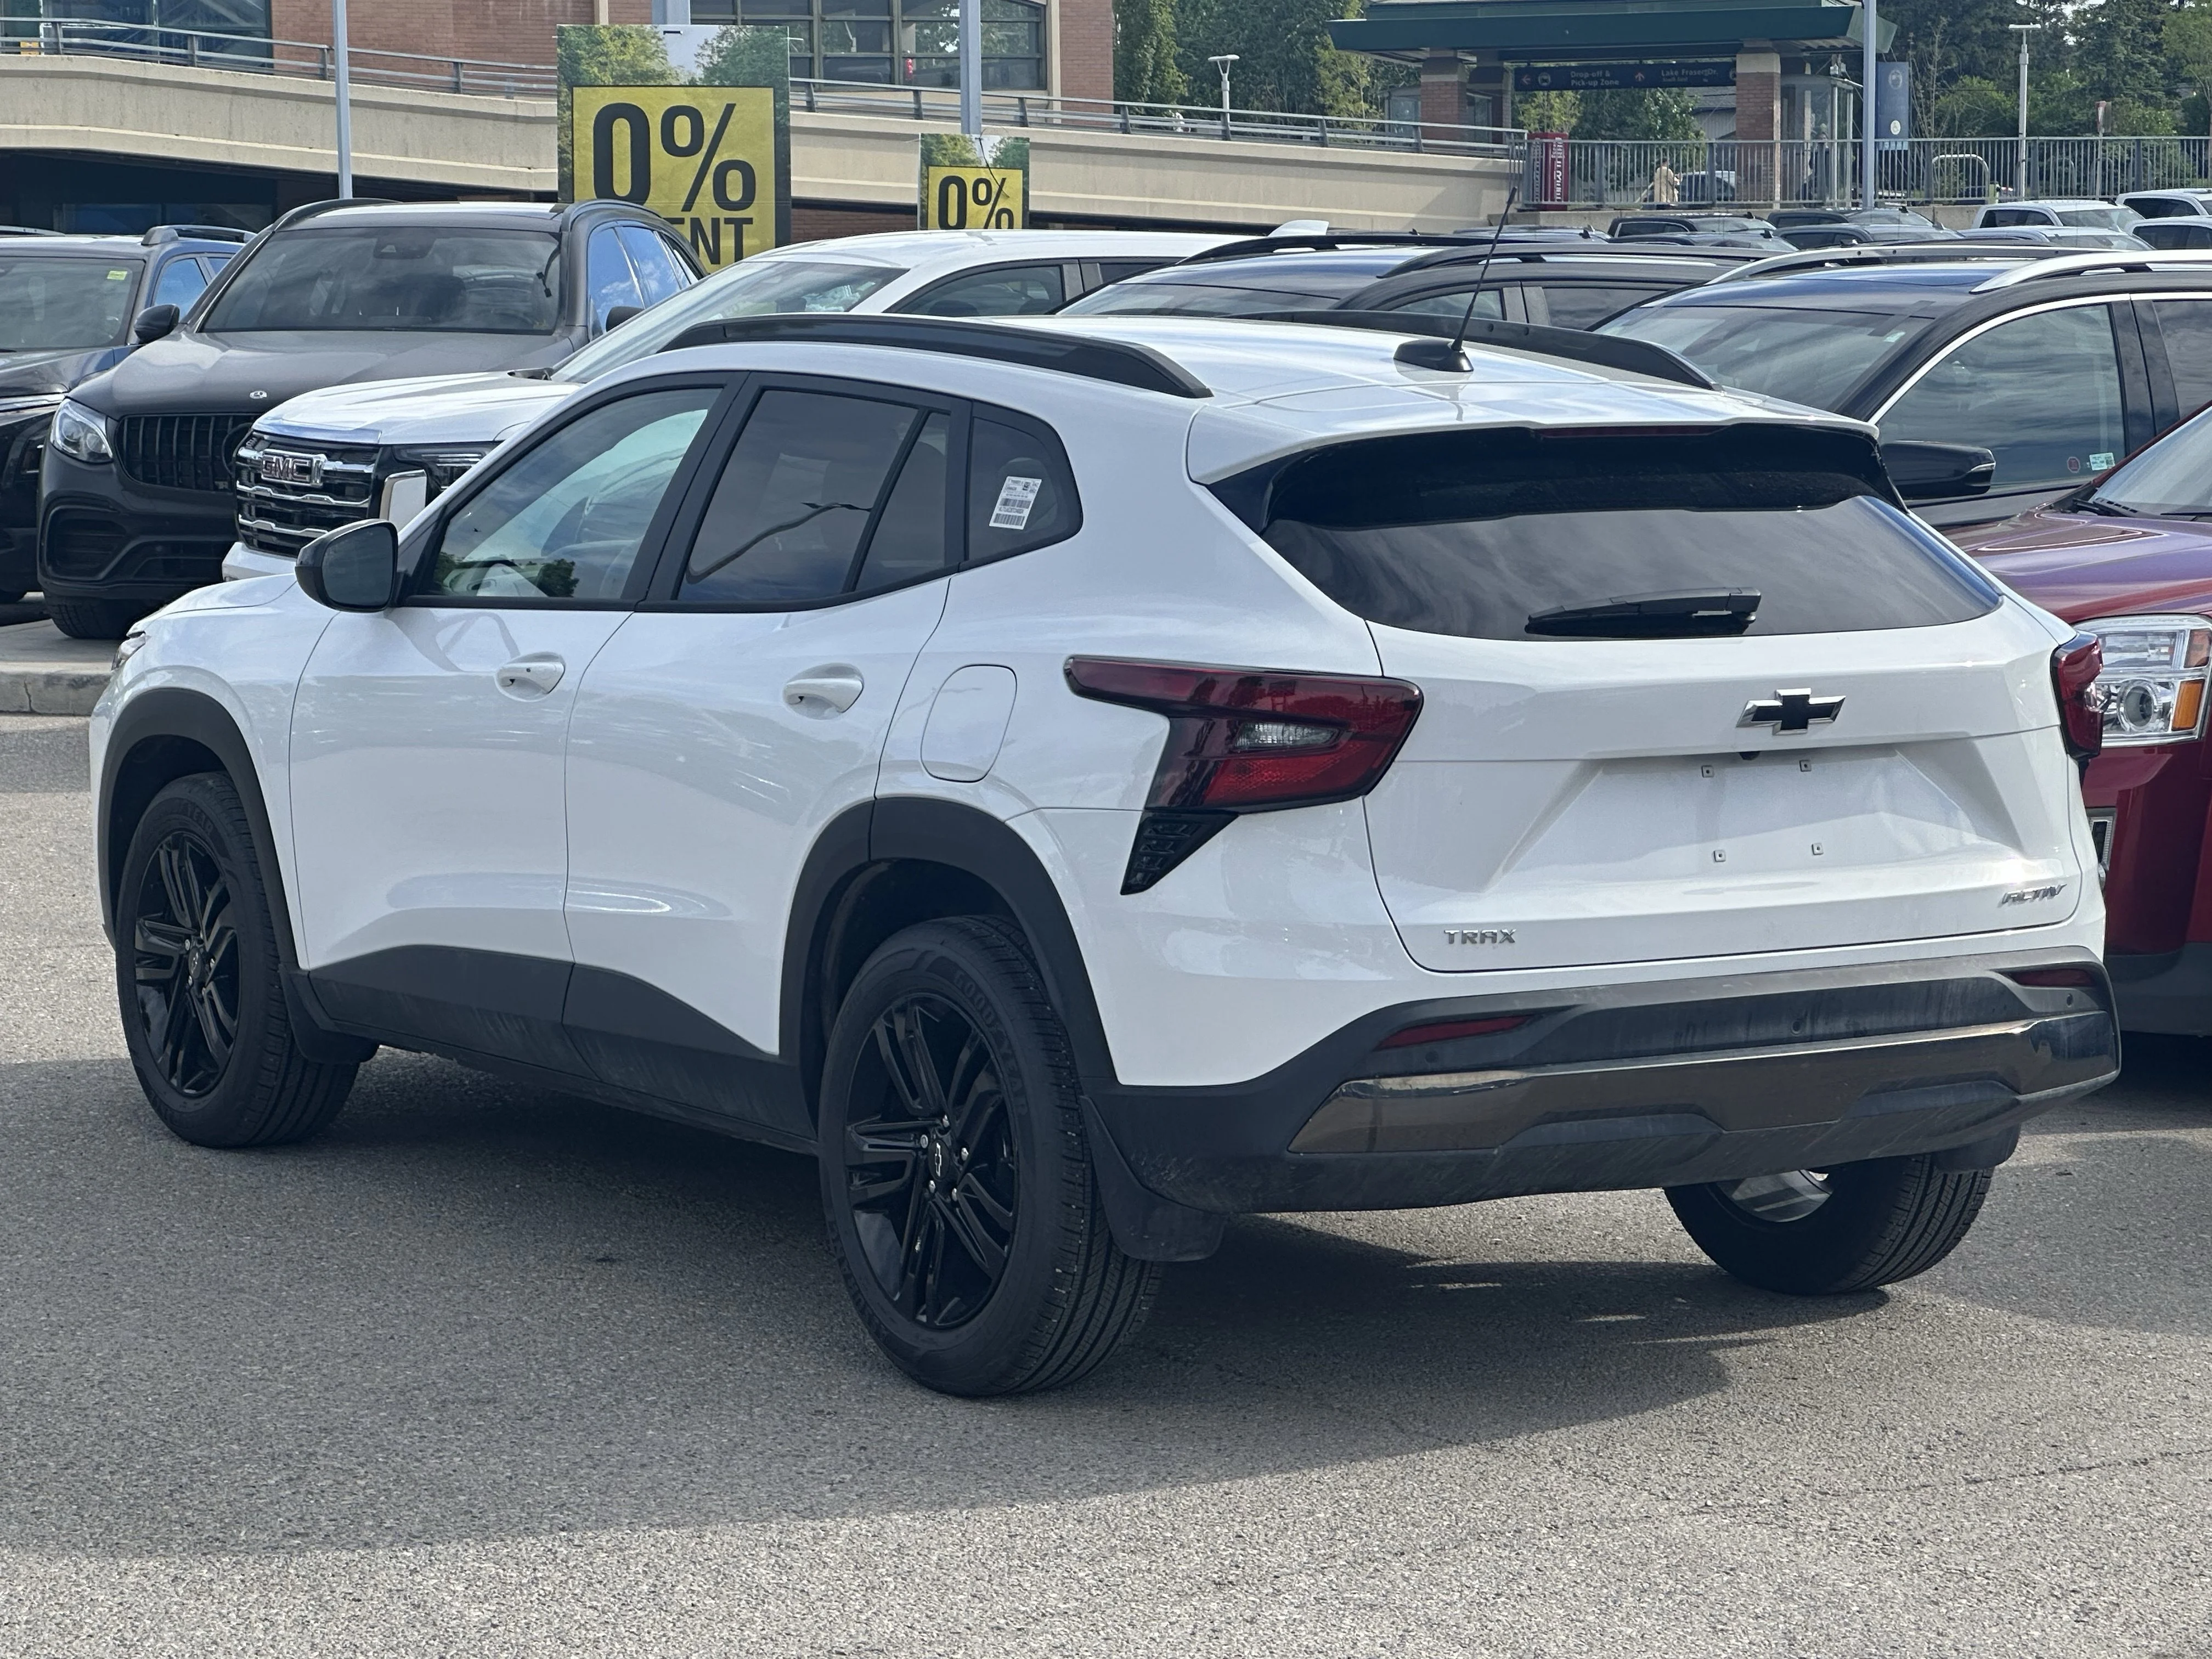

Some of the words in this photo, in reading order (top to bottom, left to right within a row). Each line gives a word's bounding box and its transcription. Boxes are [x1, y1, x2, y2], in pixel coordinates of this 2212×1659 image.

[1570, 70, 1603, 79] Drop-off
[1661, 69, 1679, 77] Lake
[1571, 79, 1598, 88] Pick-up
[592, 102, 757, 212] 0%
[938, 175, 1014, 229] 0%
[261, 453, 310, 481] GMC
[2001, 883, 2067, 905] ACTIV
[1443, 928, 1517, 945] TRAX
